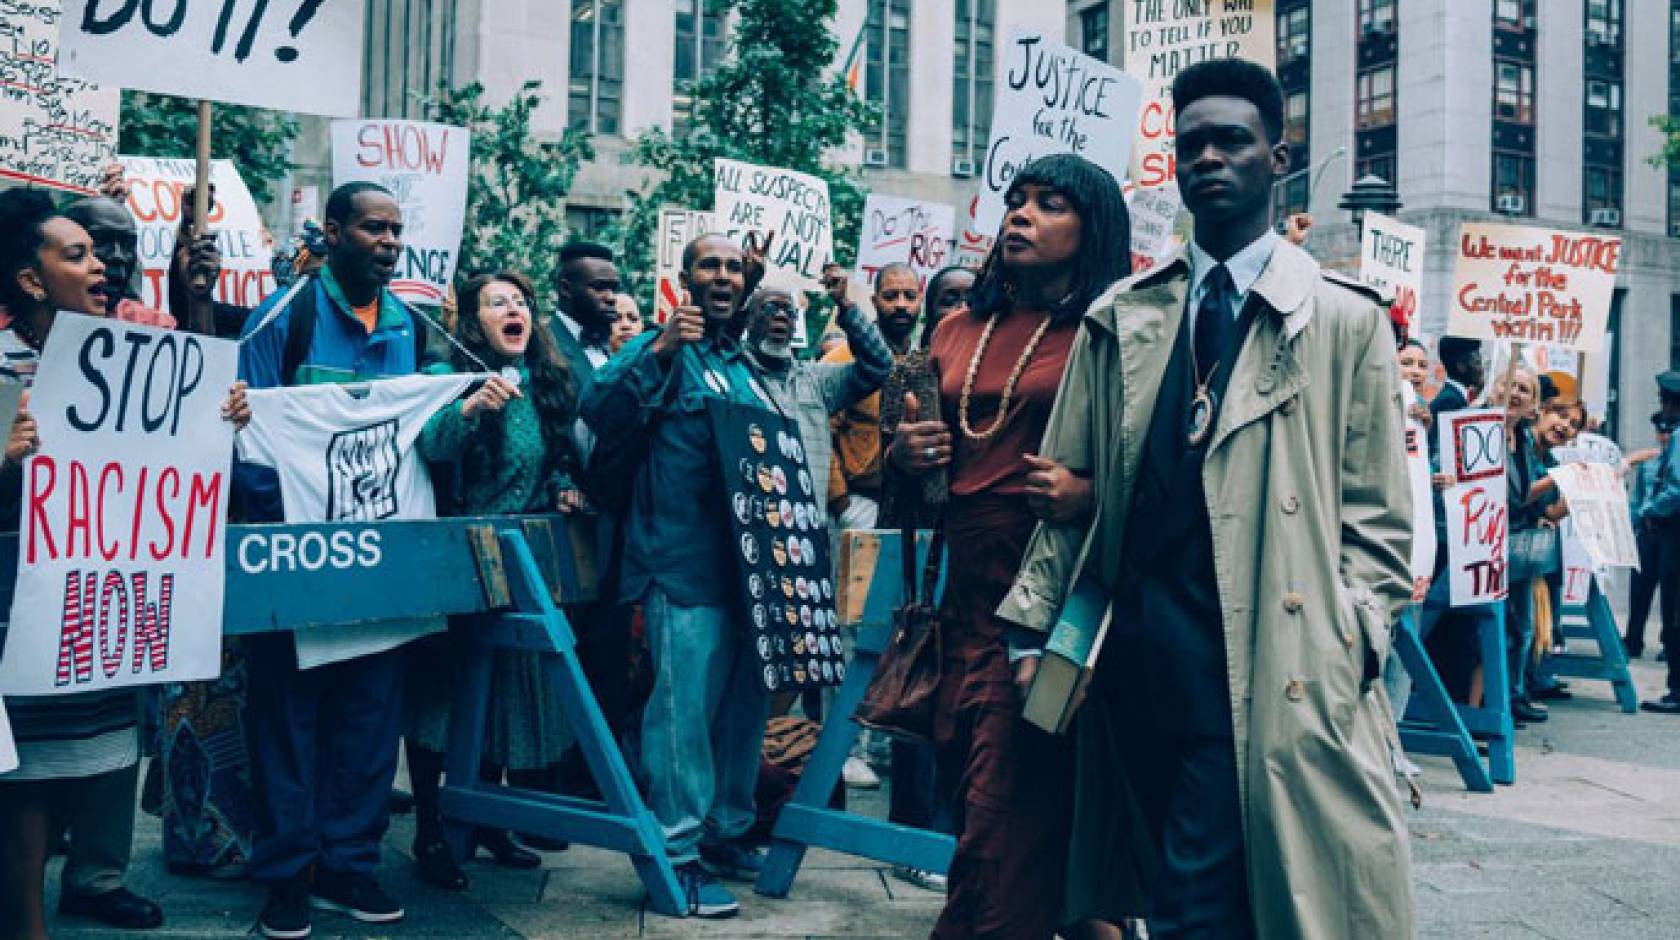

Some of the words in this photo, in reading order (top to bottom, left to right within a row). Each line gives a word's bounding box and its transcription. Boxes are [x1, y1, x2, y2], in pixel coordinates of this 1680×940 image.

[1130, 28, 1152, 51] TO
[1160, 25, 1188, 46] TELL
[1198, 20, 1211, 37] IF
[1221, 14, 1252, 36] YOU
[357, 124, 449, 174] SHOW
[717, 165, 742, 193] ALL
[730, 201, 764, 226] ARE
[781, 210, 827, 245] NOT
[1462, 232, 1496, 258] We
[1499, 244, 1543, 262] want
[1545, 234, 1621, 274] JUSTICE
[143, 268, 272, 311] JTICE
[1503, 263, 1531, 287] for
[1533, 265, 1568, 291] the
[1457, 282, 1533, 317] Central
[1537, 291, 1583, 322] Park
[66, 327, 205, 436] STOP
[27, 455, 222, 564] RACISM
[238, 530, 382, 574] CROSS
[54, 570, 175, 686] NOW
